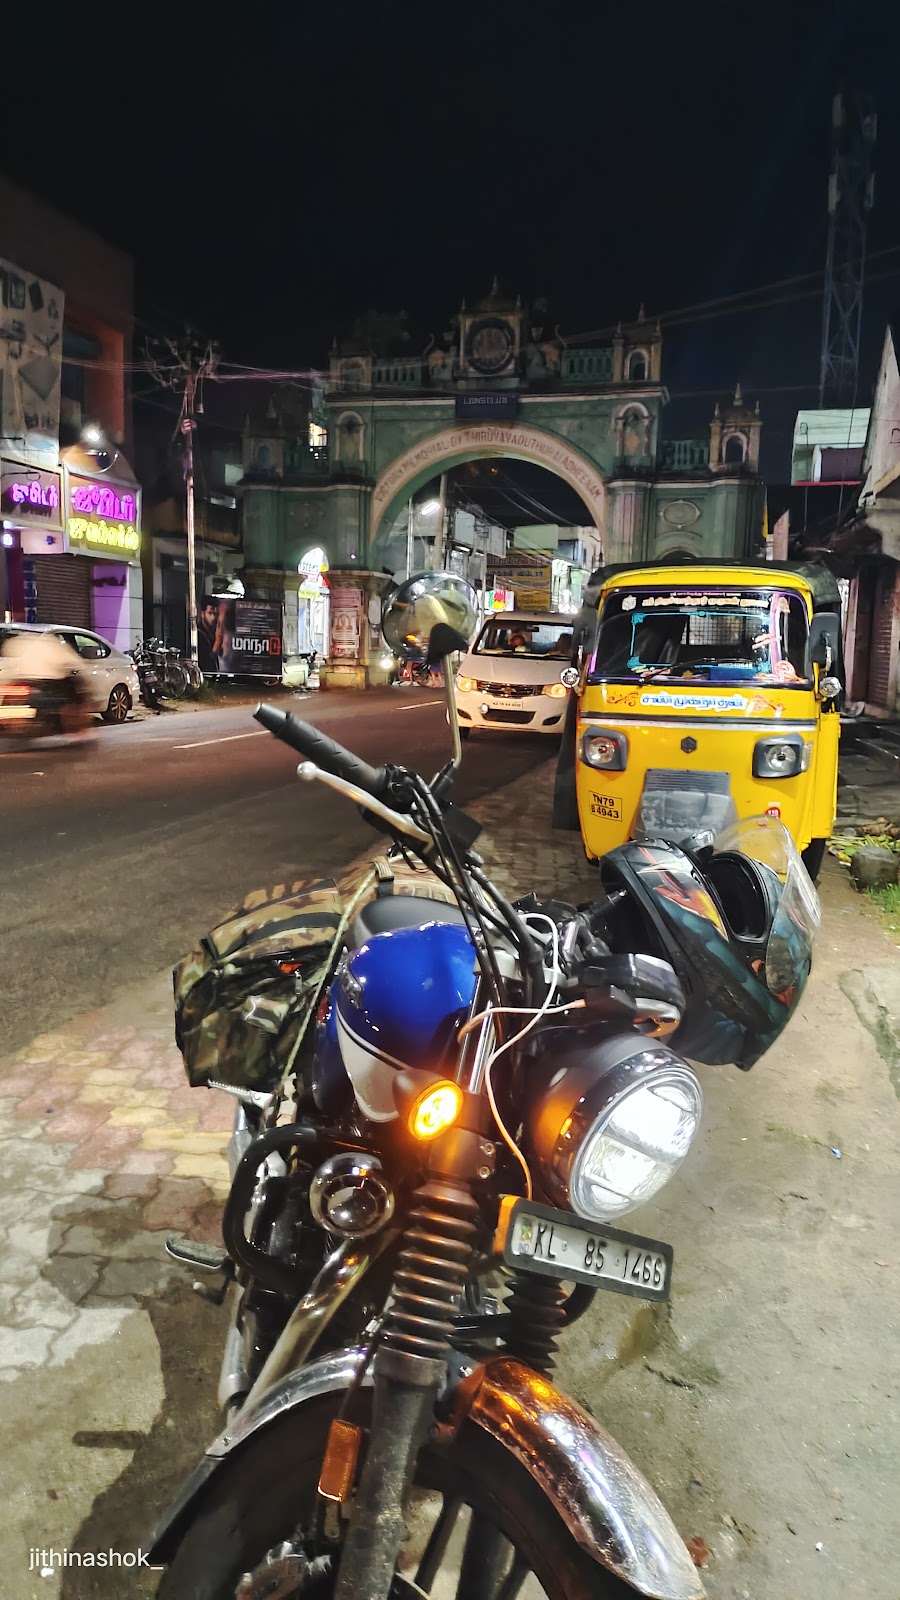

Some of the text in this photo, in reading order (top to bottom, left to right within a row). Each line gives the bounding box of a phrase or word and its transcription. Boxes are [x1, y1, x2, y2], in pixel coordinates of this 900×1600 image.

[402, 440, 449, 472] MEMORIAL
[592, 793, 615, 807] TN79
[533, 1222, 664, 1286] KL 85 1466
